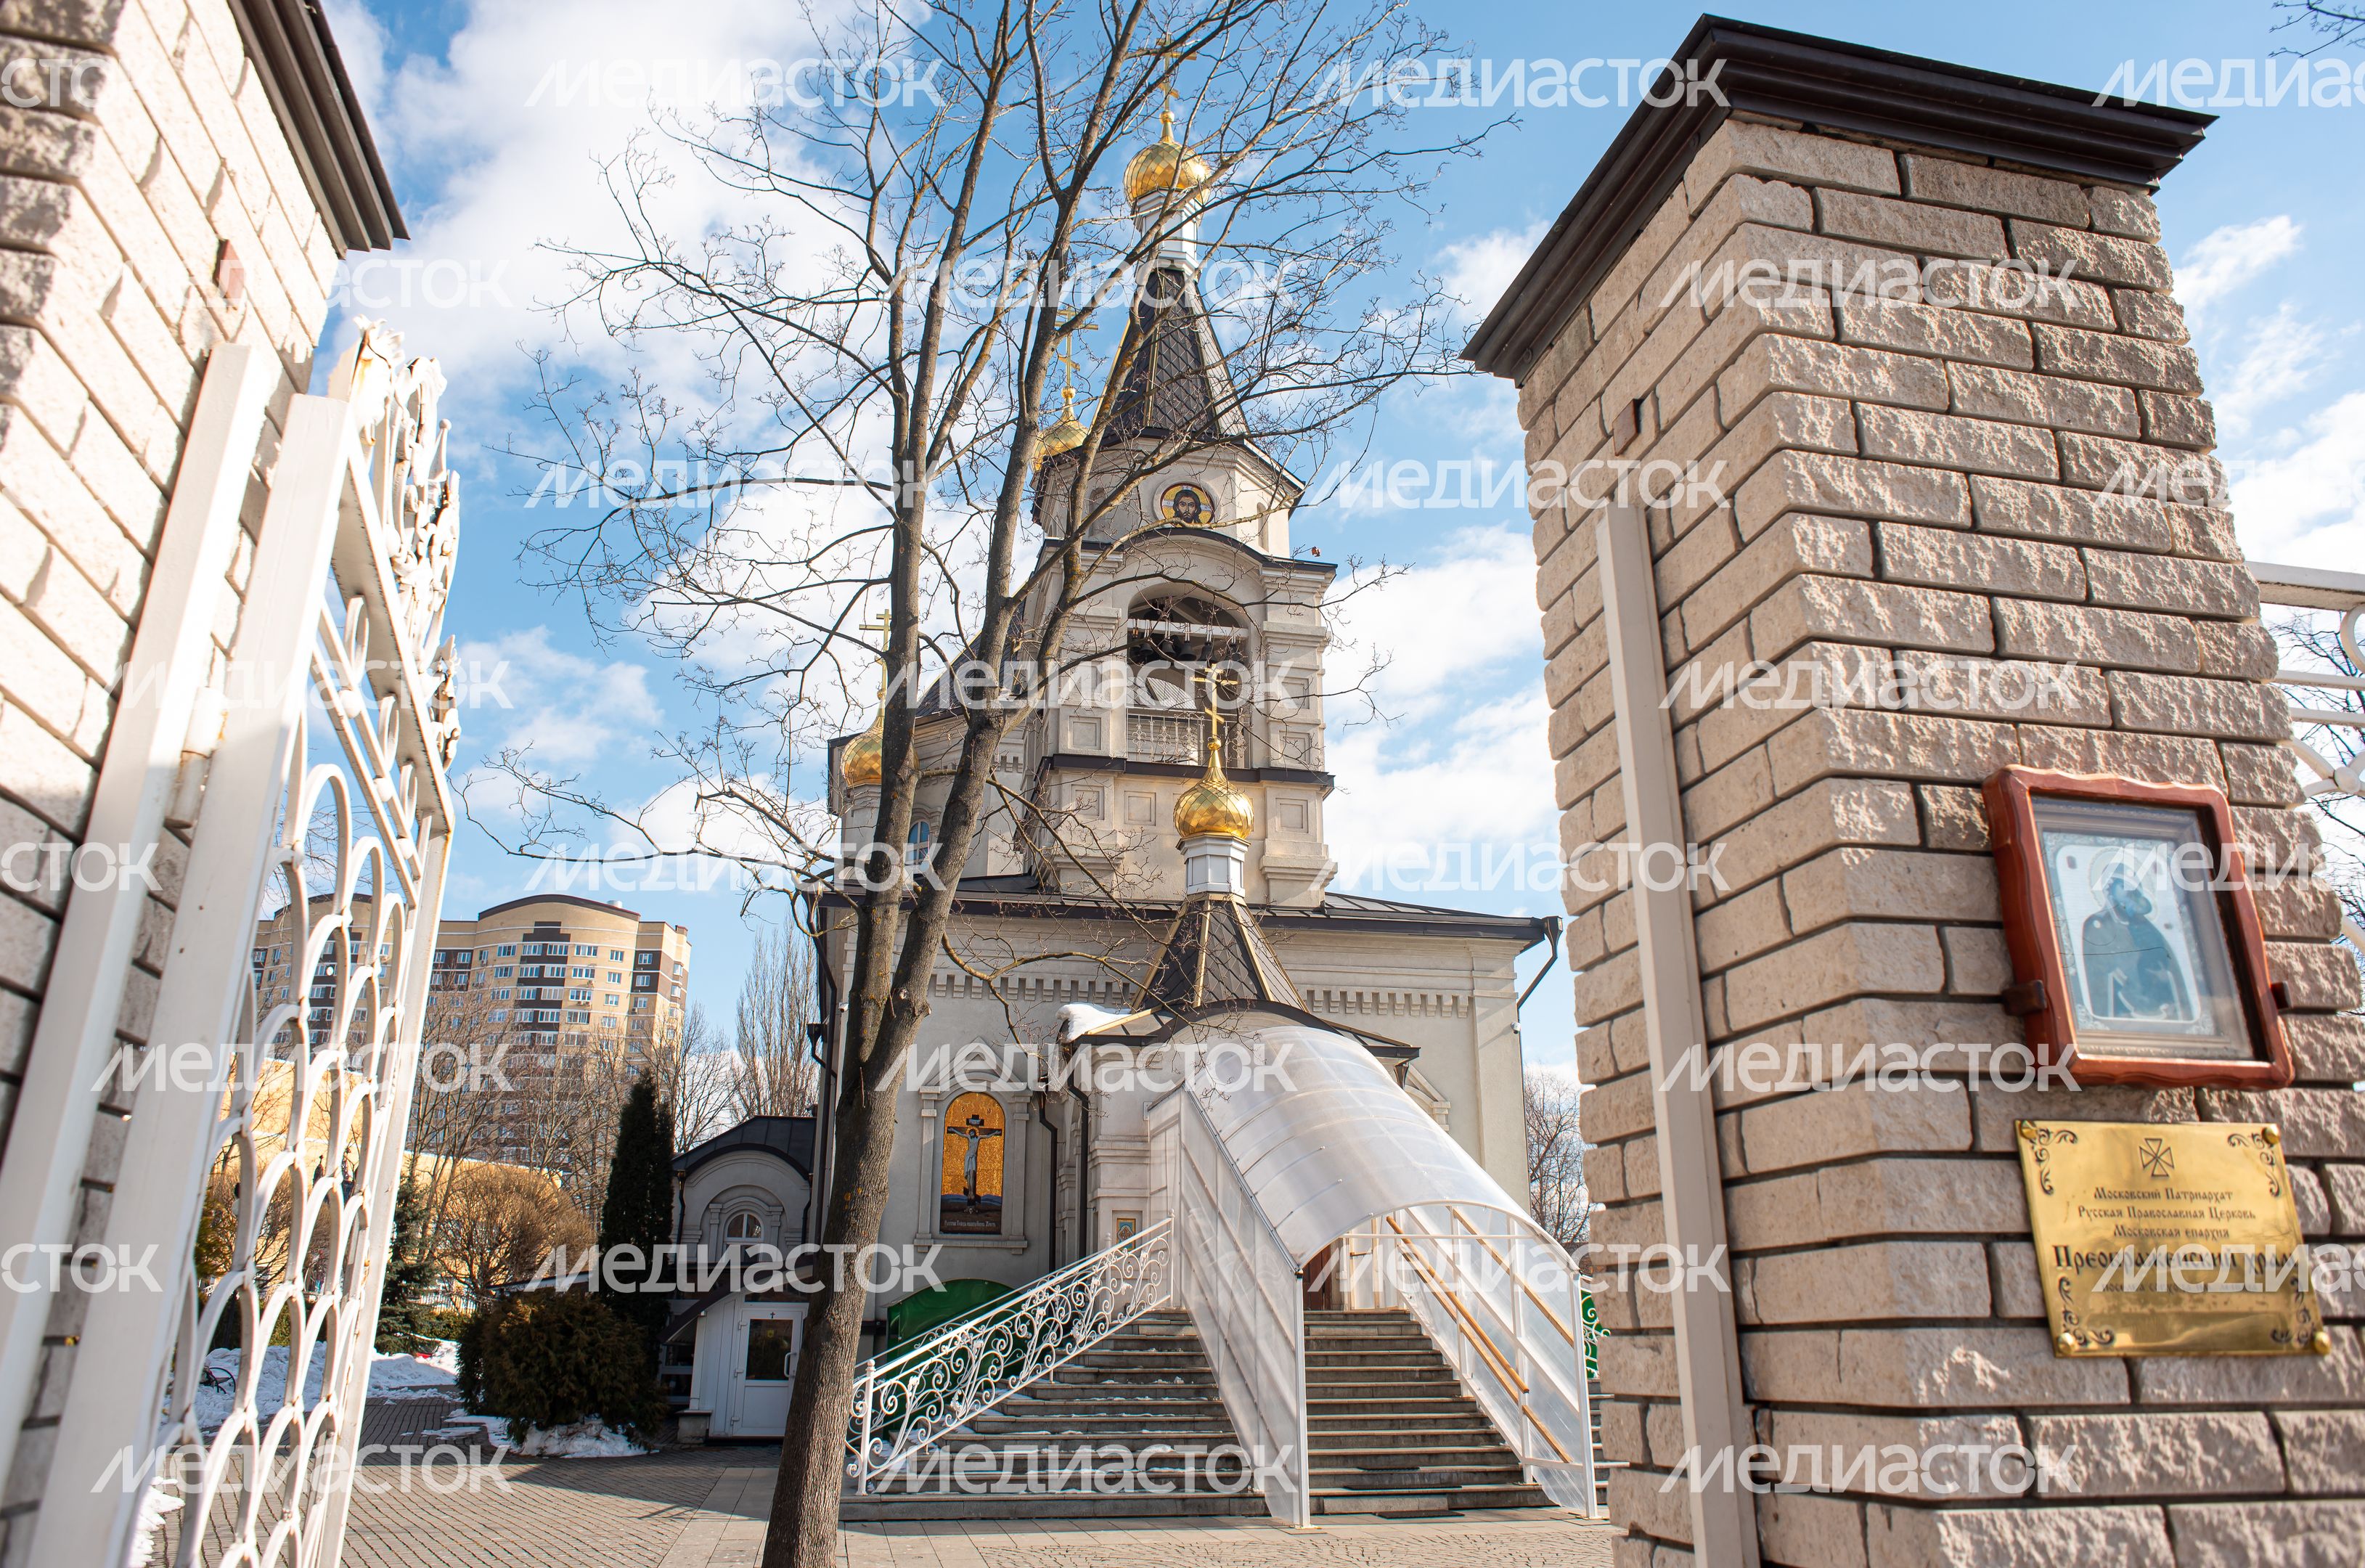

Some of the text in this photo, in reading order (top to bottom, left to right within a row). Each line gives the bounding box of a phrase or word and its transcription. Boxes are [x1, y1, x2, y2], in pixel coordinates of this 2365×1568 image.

[2094, 1186, 2234, 1203] Московский Патриархат
[2078, 1205, 2256, 1222] Русская Православная Церковь
[2113, 1224, 2181, 1238] Московская
